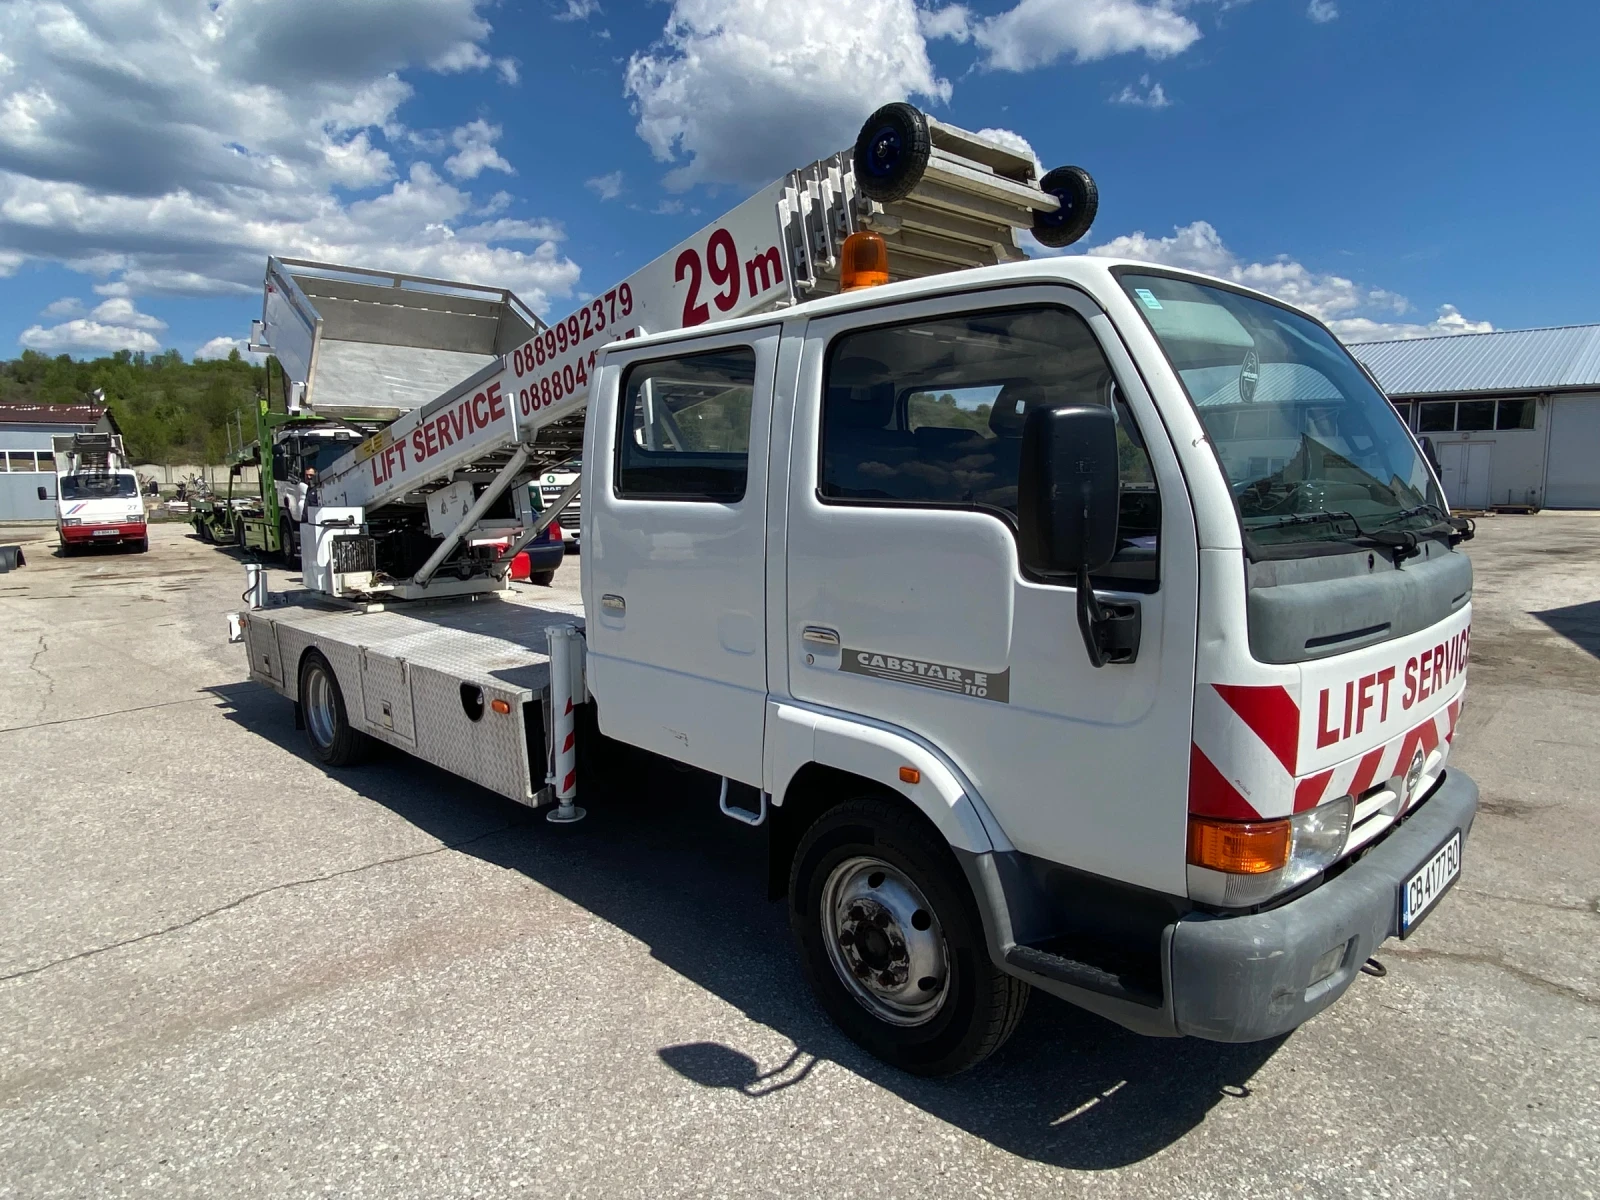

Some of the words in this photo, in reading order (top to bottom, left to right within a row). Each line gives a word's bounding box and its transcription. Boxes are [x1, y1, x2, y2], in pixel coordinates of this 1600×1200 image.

[675, 228, 740, 328] 29
[745, 246, 784, 298] m
[514, 282, 633, 378] 0889992379
[371, 439, 407, 487] LIFT
[413, 381, 506, 463] SERVICE
[964, 684, 987, 697] 110
[1316, 665, 1396, 750] LIFT
[1409, 875, 1424, 916] CB
